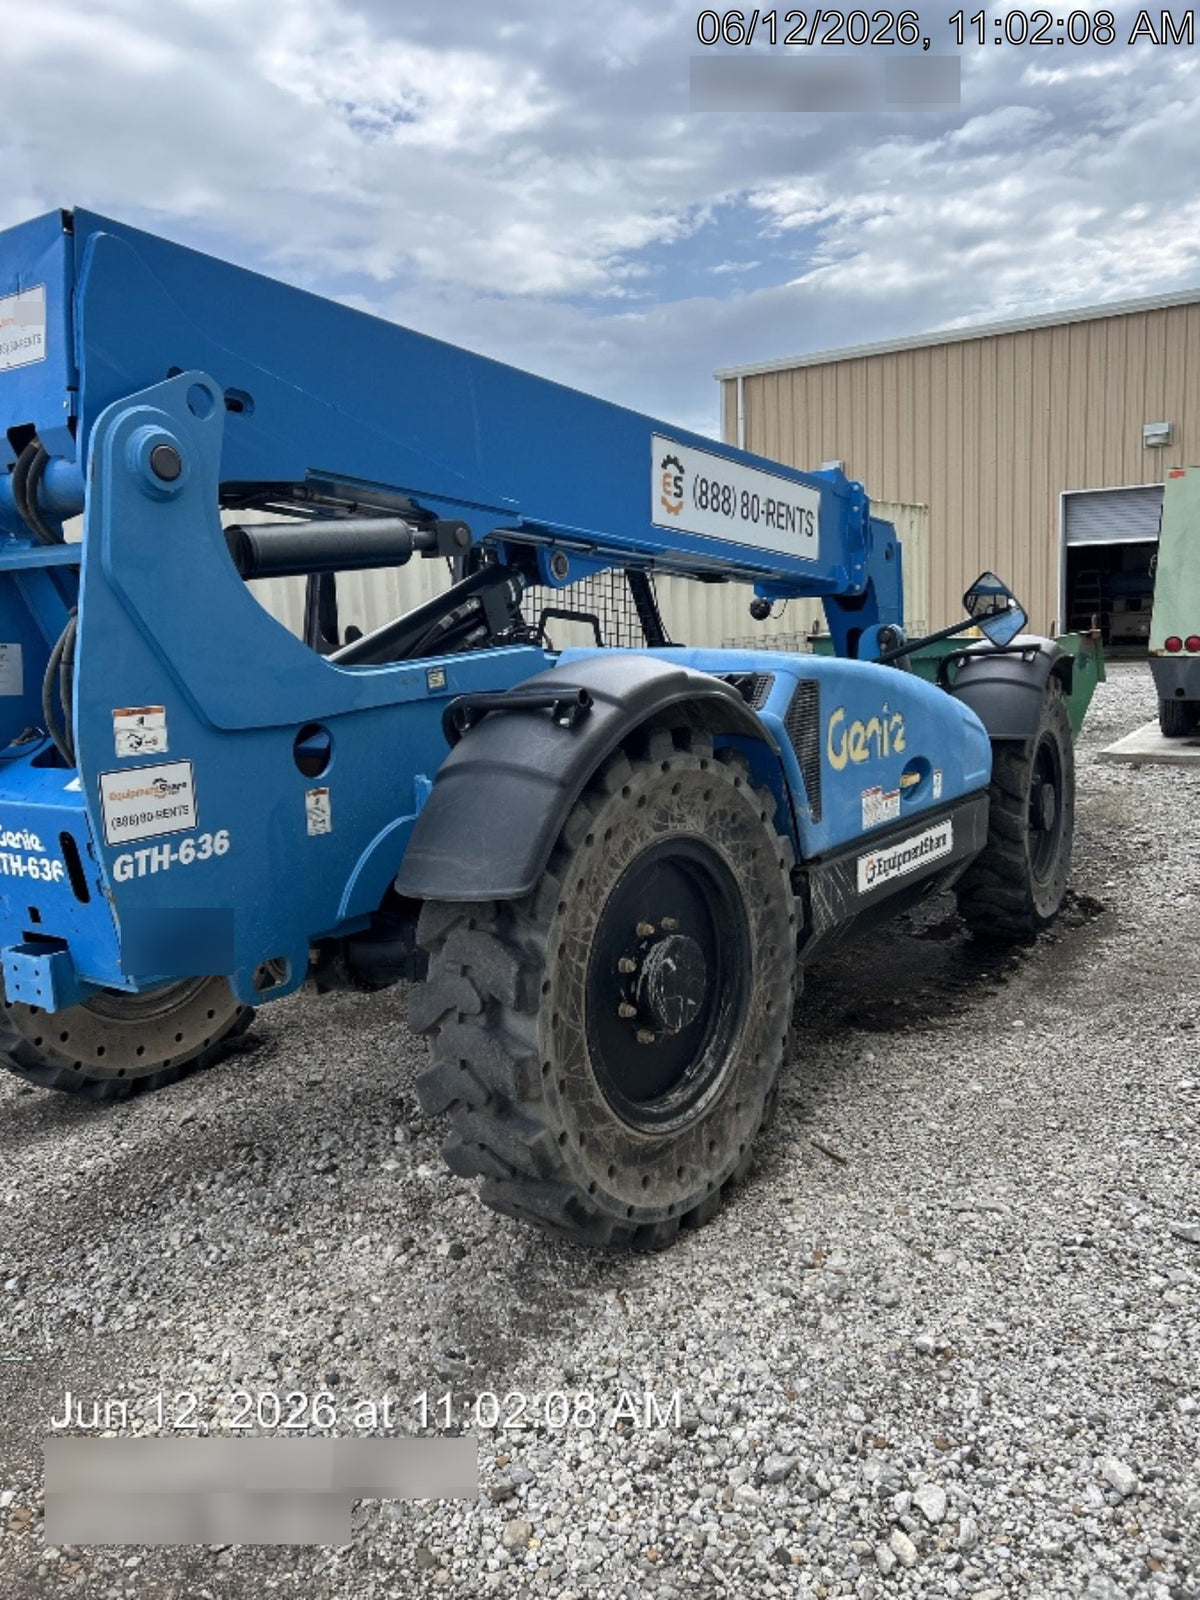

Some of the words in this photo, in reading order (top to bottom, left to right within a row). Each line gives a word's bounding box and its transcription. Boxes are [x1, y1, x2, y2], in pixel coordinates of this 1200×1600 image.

[692, 474, 737, 520] (888)
[740, 490, 815, 538] 80-RENTS
[827, 702, 906, 772] Genie
[0, 853, 65, 882] TH-636
[113, 829, 230, 882] GTH-636
